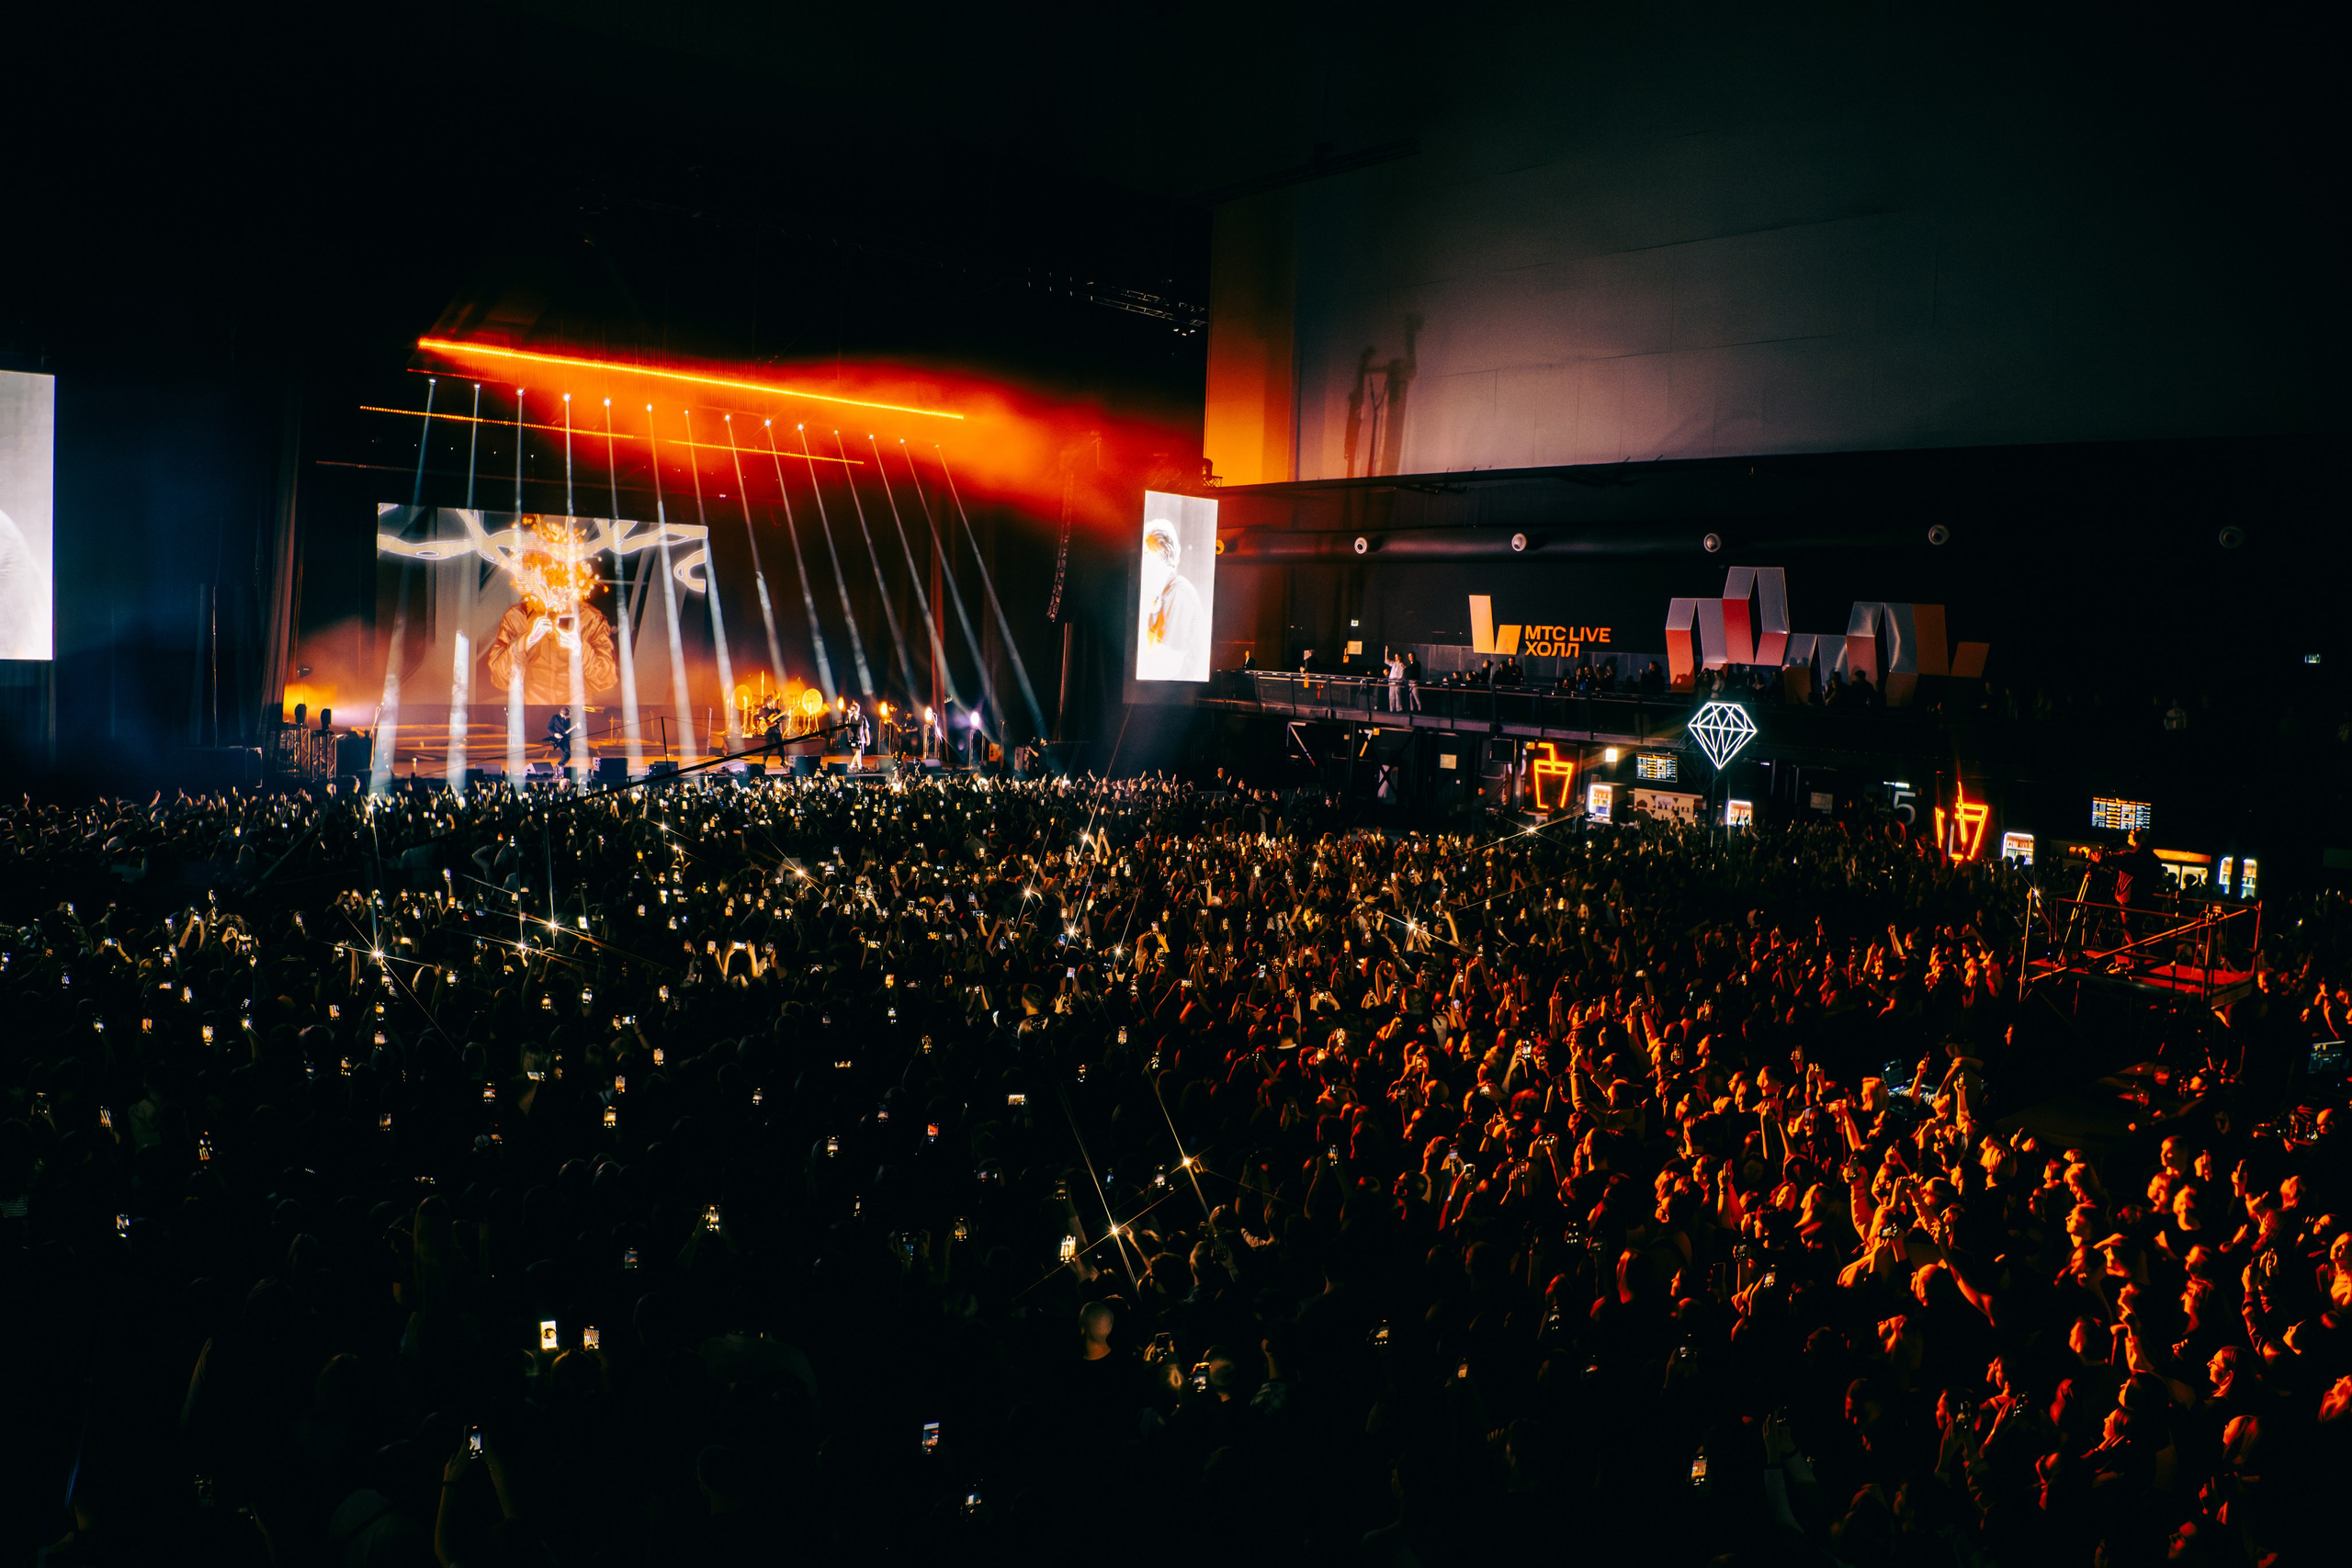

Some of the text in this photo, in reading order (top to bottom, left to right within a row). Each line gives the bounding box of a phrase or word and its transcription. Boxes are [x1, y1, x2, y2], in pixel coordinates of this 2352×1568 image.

[1569, 626, 1611, 643] LIVE
[1525, 641, 1579, 658] ХОЛЛ
[1894, 791, 1916, 826] 5
